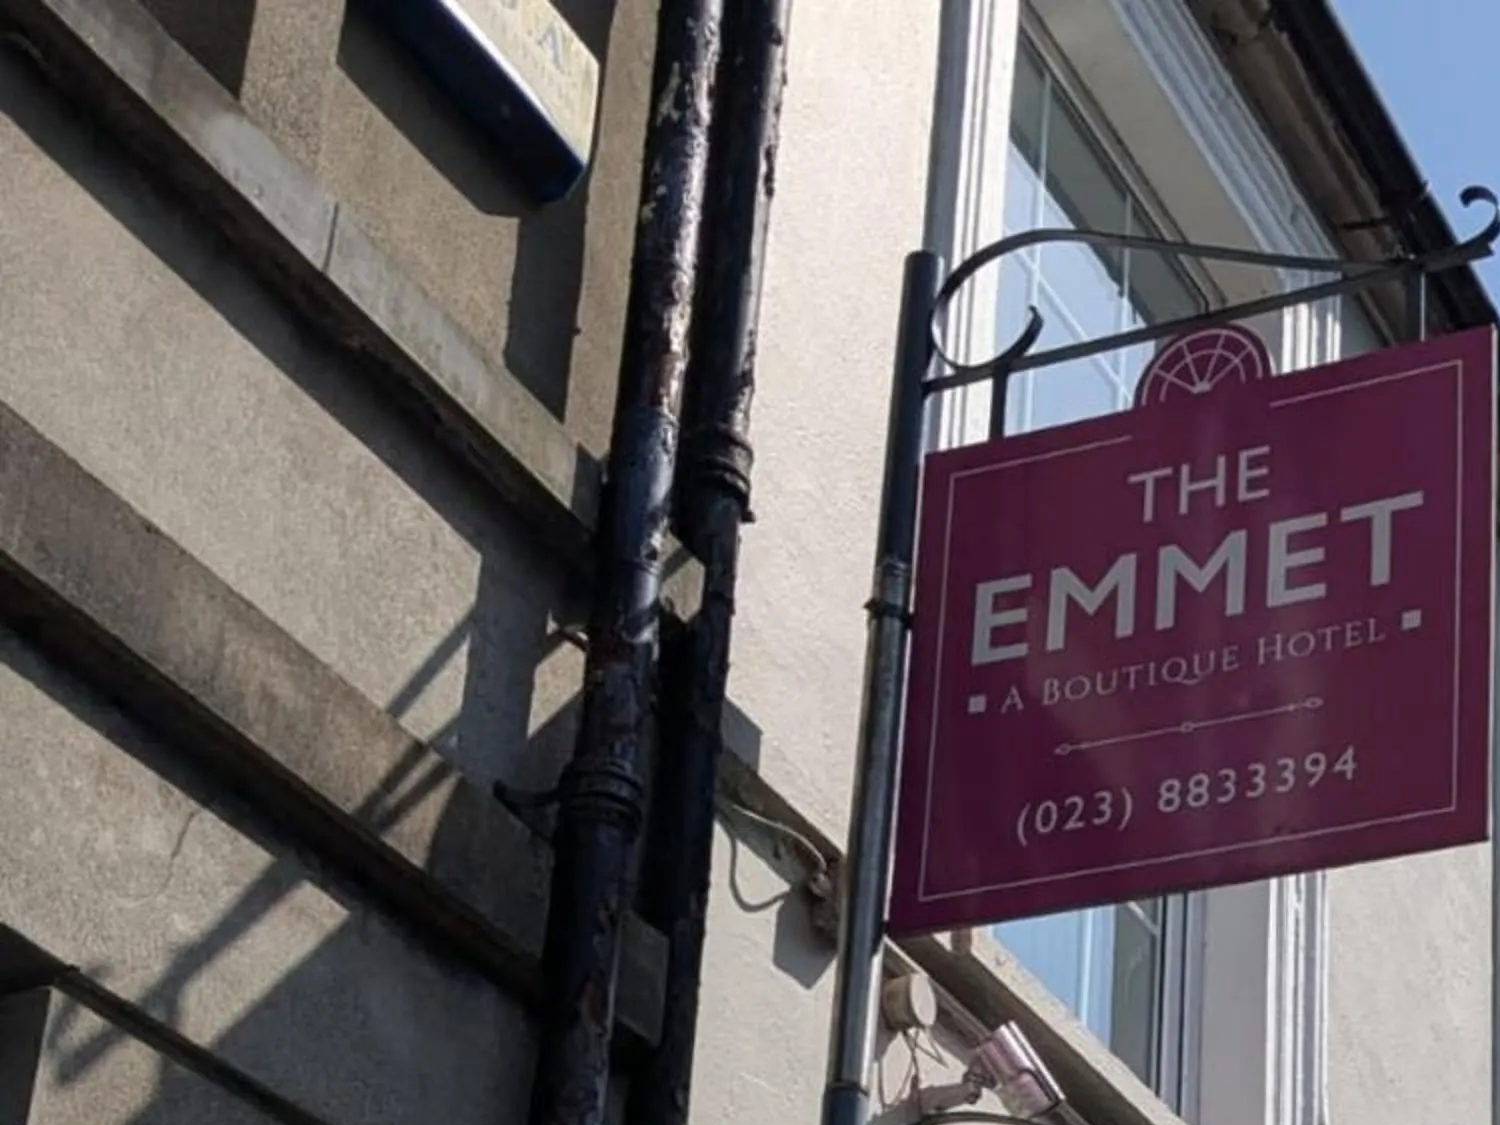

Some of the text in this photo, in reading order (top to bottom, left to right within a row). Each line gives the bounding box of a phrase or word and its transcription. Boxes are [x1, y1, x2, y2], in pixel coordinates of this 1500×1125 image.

[1128, 446, 1270, 523] THE
[970, 491, 1424, 666] EMMET
[1001, 617, 1387, 714] A BOUTIQUE HOTEL
[1016, 745, 1357, 848] (023) 8833394
